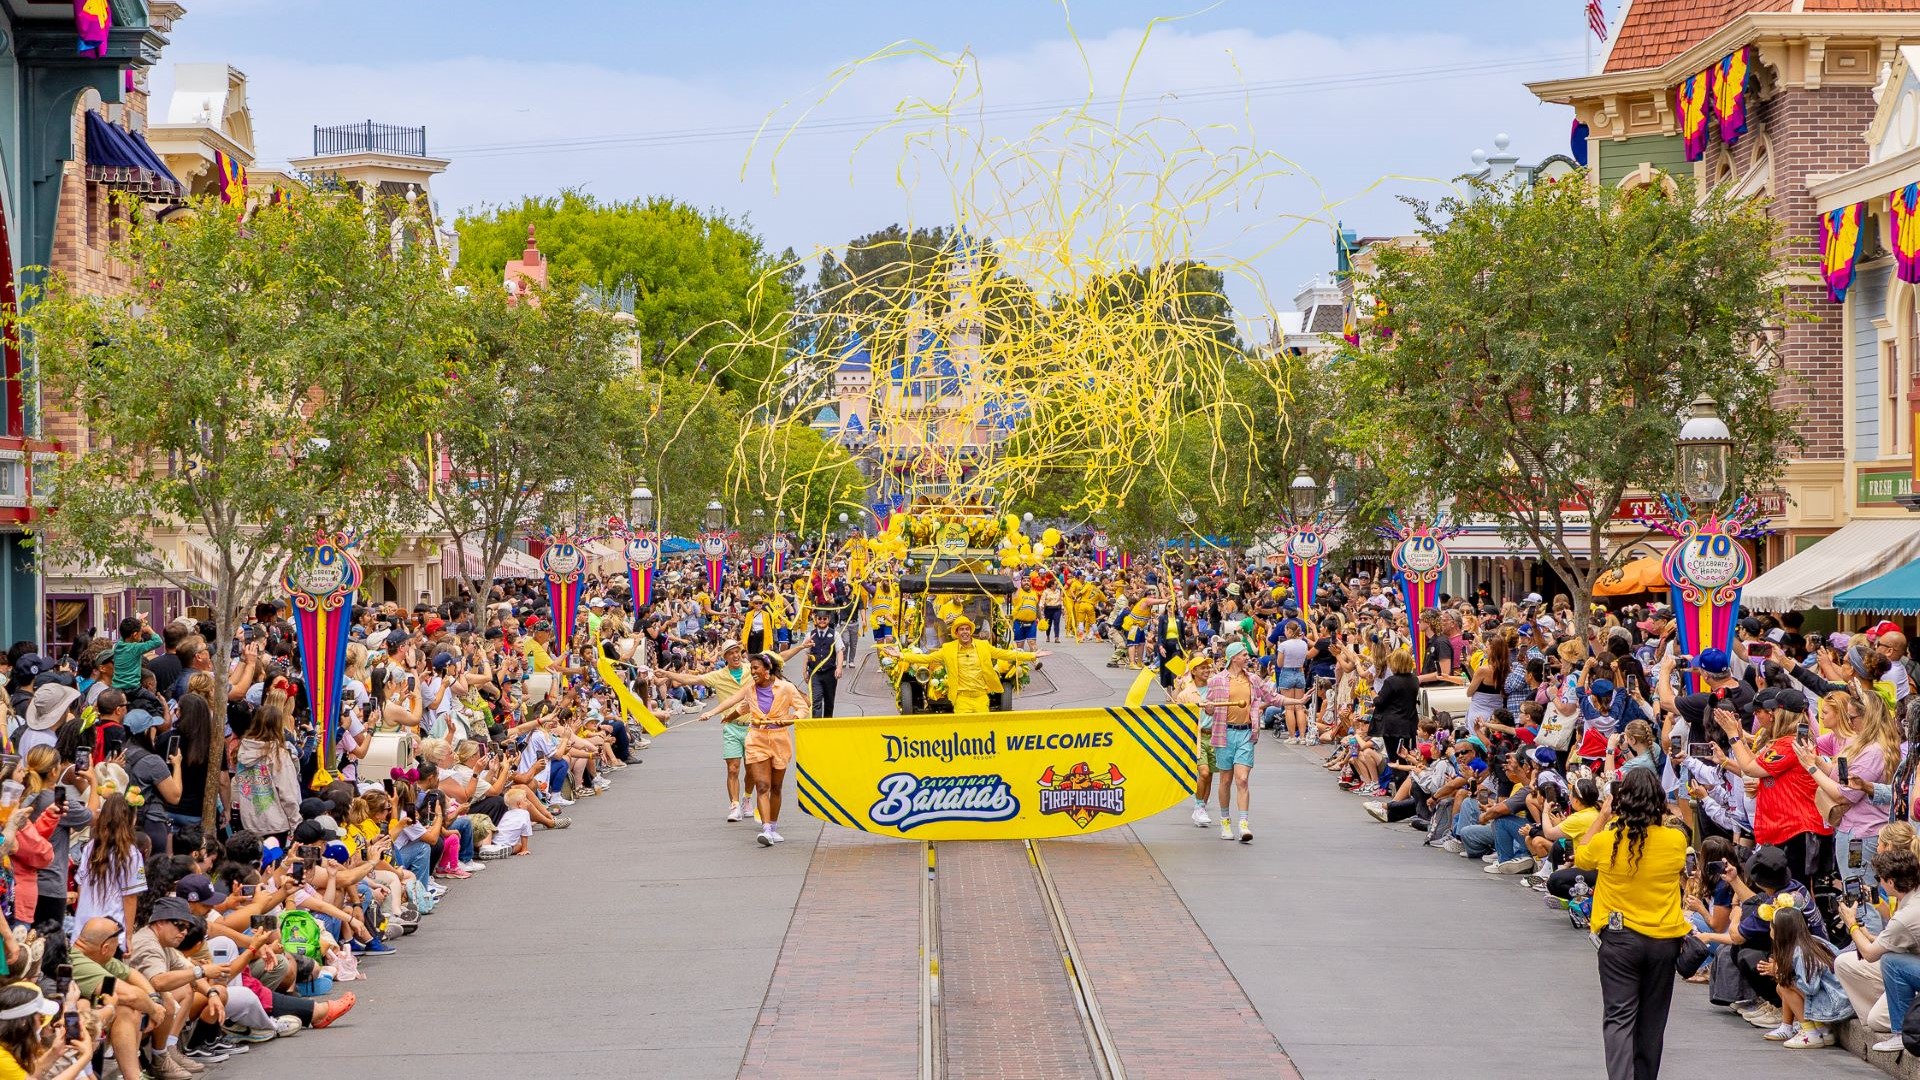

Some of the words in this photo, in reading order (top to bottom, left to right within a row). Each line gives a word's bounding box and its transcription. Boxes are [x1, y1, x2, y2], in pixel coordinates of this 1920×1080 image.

[1868, 479, 1892, 496] FRESH
[634, 538, 649, 549] 70
[709, 538, 720, 546] 70
[1299, 532, 1316, 543] 70
[1411, 536, 1434, 551] 70
[554, 544, 574, 557] 70
[1695, 534, 1732, 557] 70
[303, 545, 335, 566] 70
[1693, 560, 1728, 569] CELEBRATE
[881, 730, 996, 763] Disneyland
[1006, 732, 1113, 751] WELCOMES
[920, 776, 998, 788] SAVANNAH
[871, 773, 1015, 827] Bananas
[1041, 788, 1124, 812] FIREFIGHTERS
